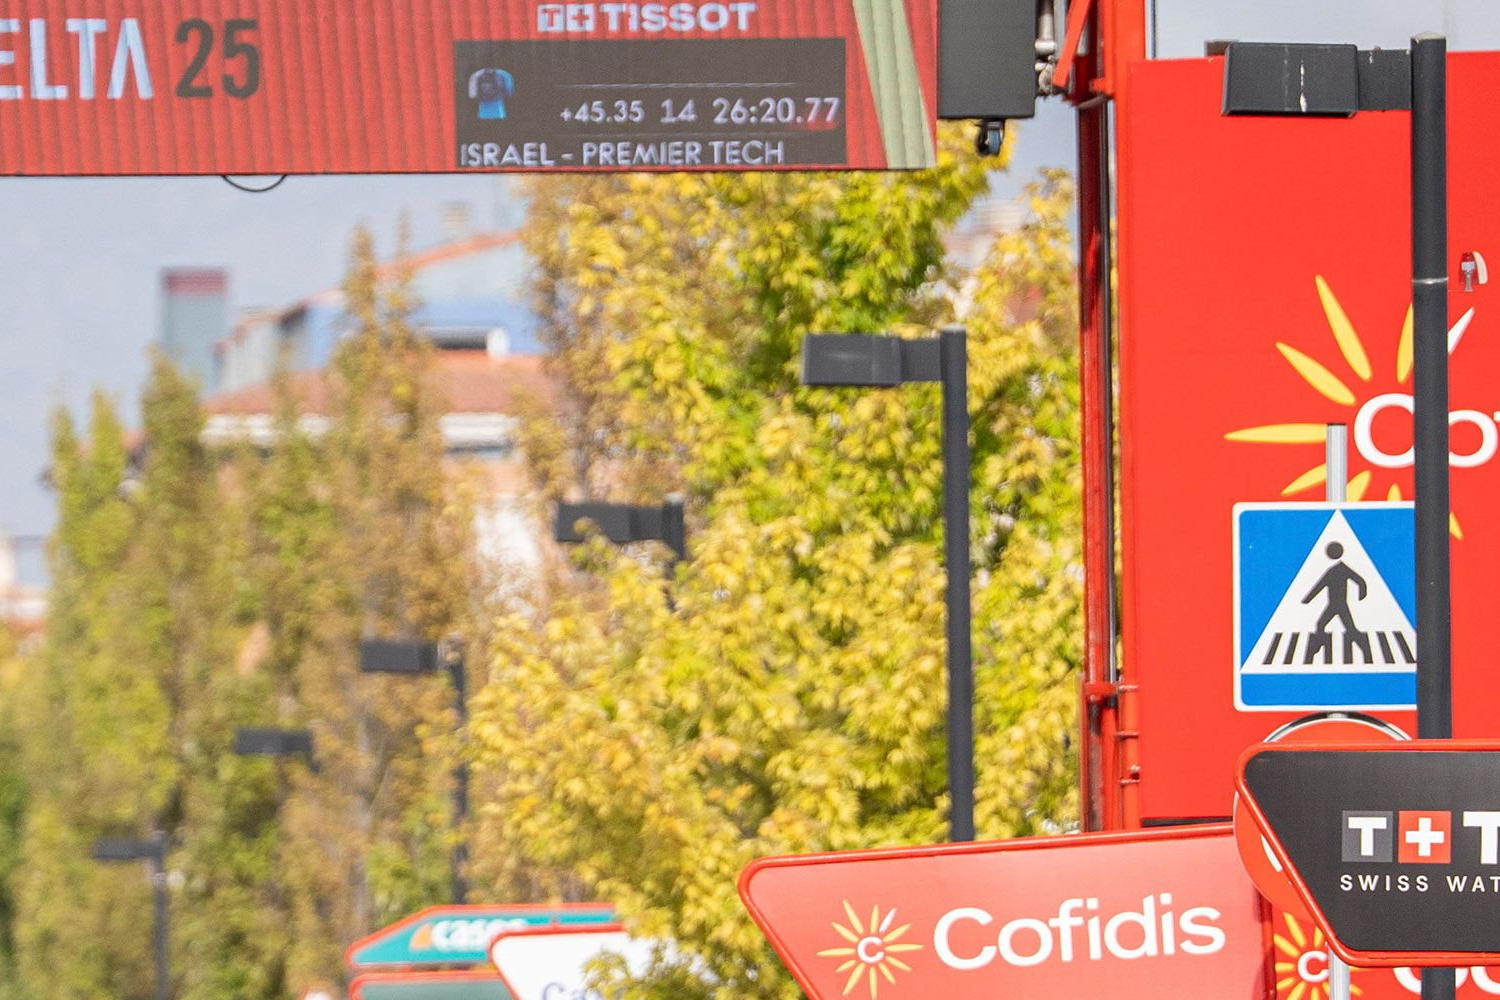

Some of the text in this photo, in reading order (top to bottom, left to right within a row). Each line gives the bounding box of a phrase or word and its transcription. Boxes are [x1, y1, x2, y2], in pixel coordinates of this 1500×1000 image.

[605, 3, 756, 31] TISSOT
[174, 18, 261, 100] 25
[560, 97, 841, 124] +45.35 14 26:20.77
[460, 143, 553, 166] ISRAEL
[582, 141, 700, 165] PREMIER
[709, 140, 785, 164] TECH
[1340, 874, 1429, 892] SWISS
[933, 893, 1226, 970] Cofidis
